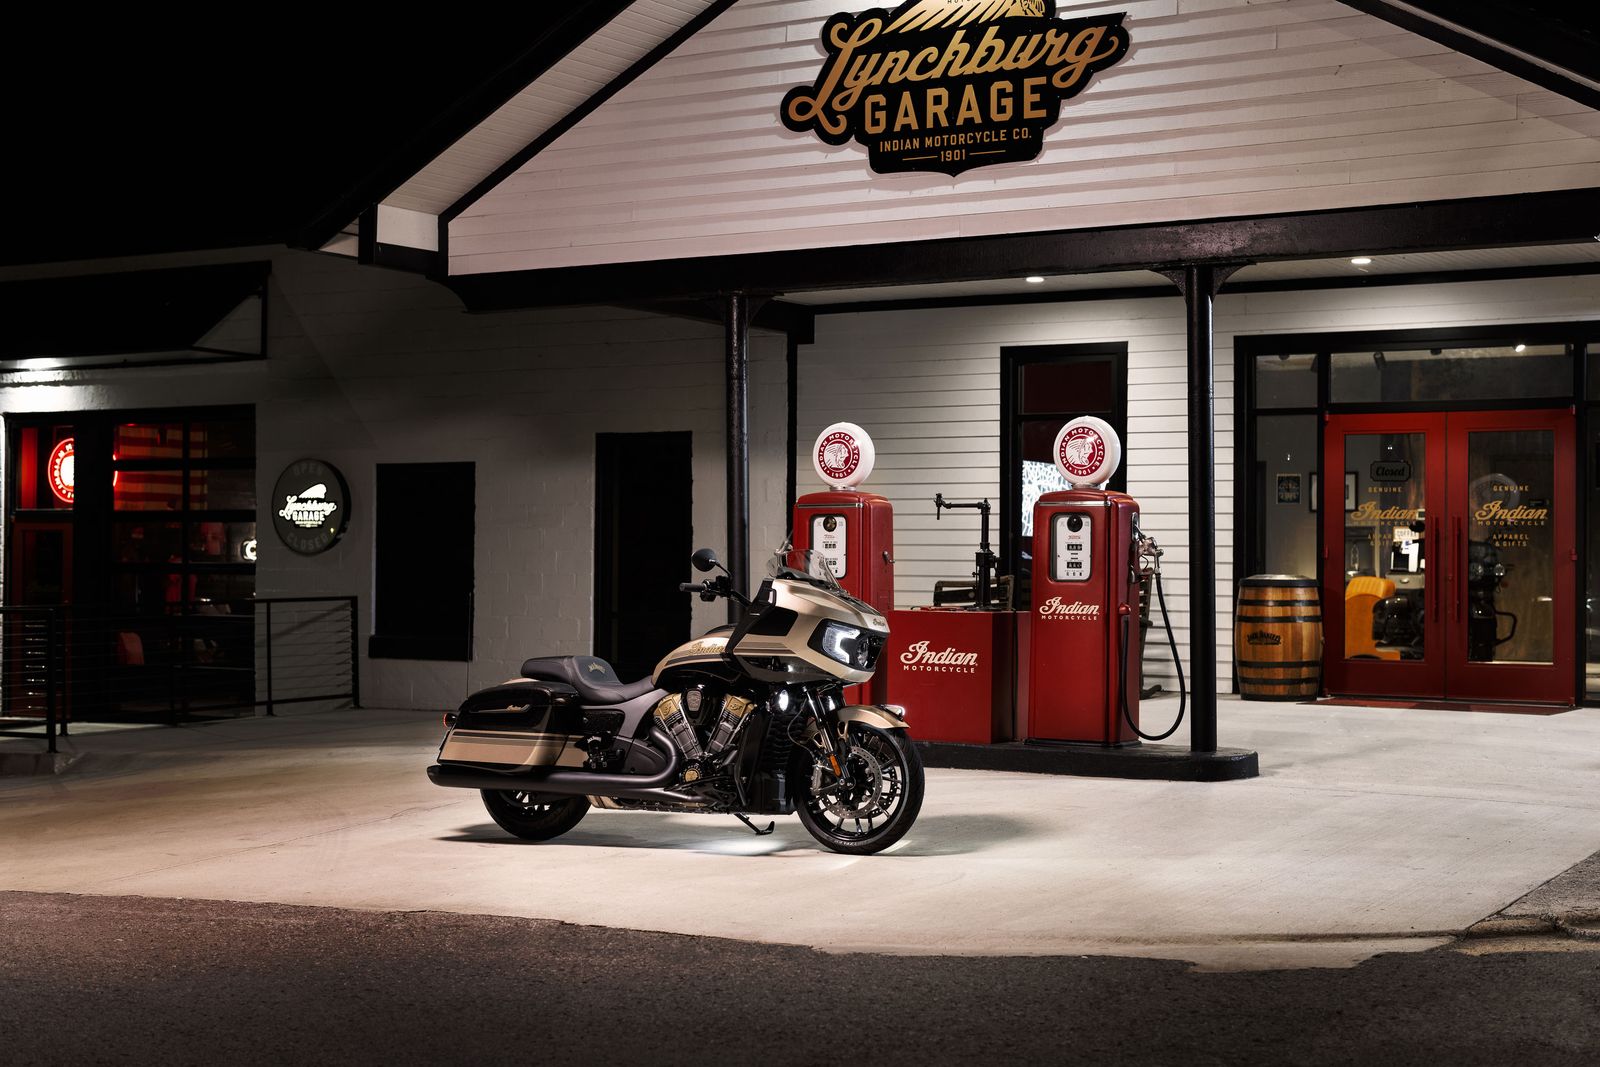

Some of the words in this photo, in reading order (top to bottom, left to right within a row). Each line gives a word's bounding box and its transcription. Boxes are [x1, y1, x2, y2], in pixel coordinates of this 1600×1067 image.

[788, 17, 1119, 135] Lynchburg
[864, 76, 1048, 134] GARAGE
[879, 138, 921, 153] INDIAN
[924, 130, 1007, 149] MOTORCYCLE
[1012, 127, 1032, 140] CO.
[940, 148, 966, 162] 1901
[819, 441, 828, 471] INDIAN
[829, 433, 859, 470] MOTORCYCLE
[1061, 435, 1070, 468] INDIAN
[1071, 428, 1104, 467] MOTORCYCLE
[1376, 466, 1405, 477] Closed
[293, 511, 325, 521] GARAGE
[1351, 500, 1418, 520] Indian
[1474, 500, 1548, 520] Indian
[1039, 596, 1099, 615] Indian
[900, 640, 977, 666] Indian
[903, 665, 976, 674] MOTORCYCLE
